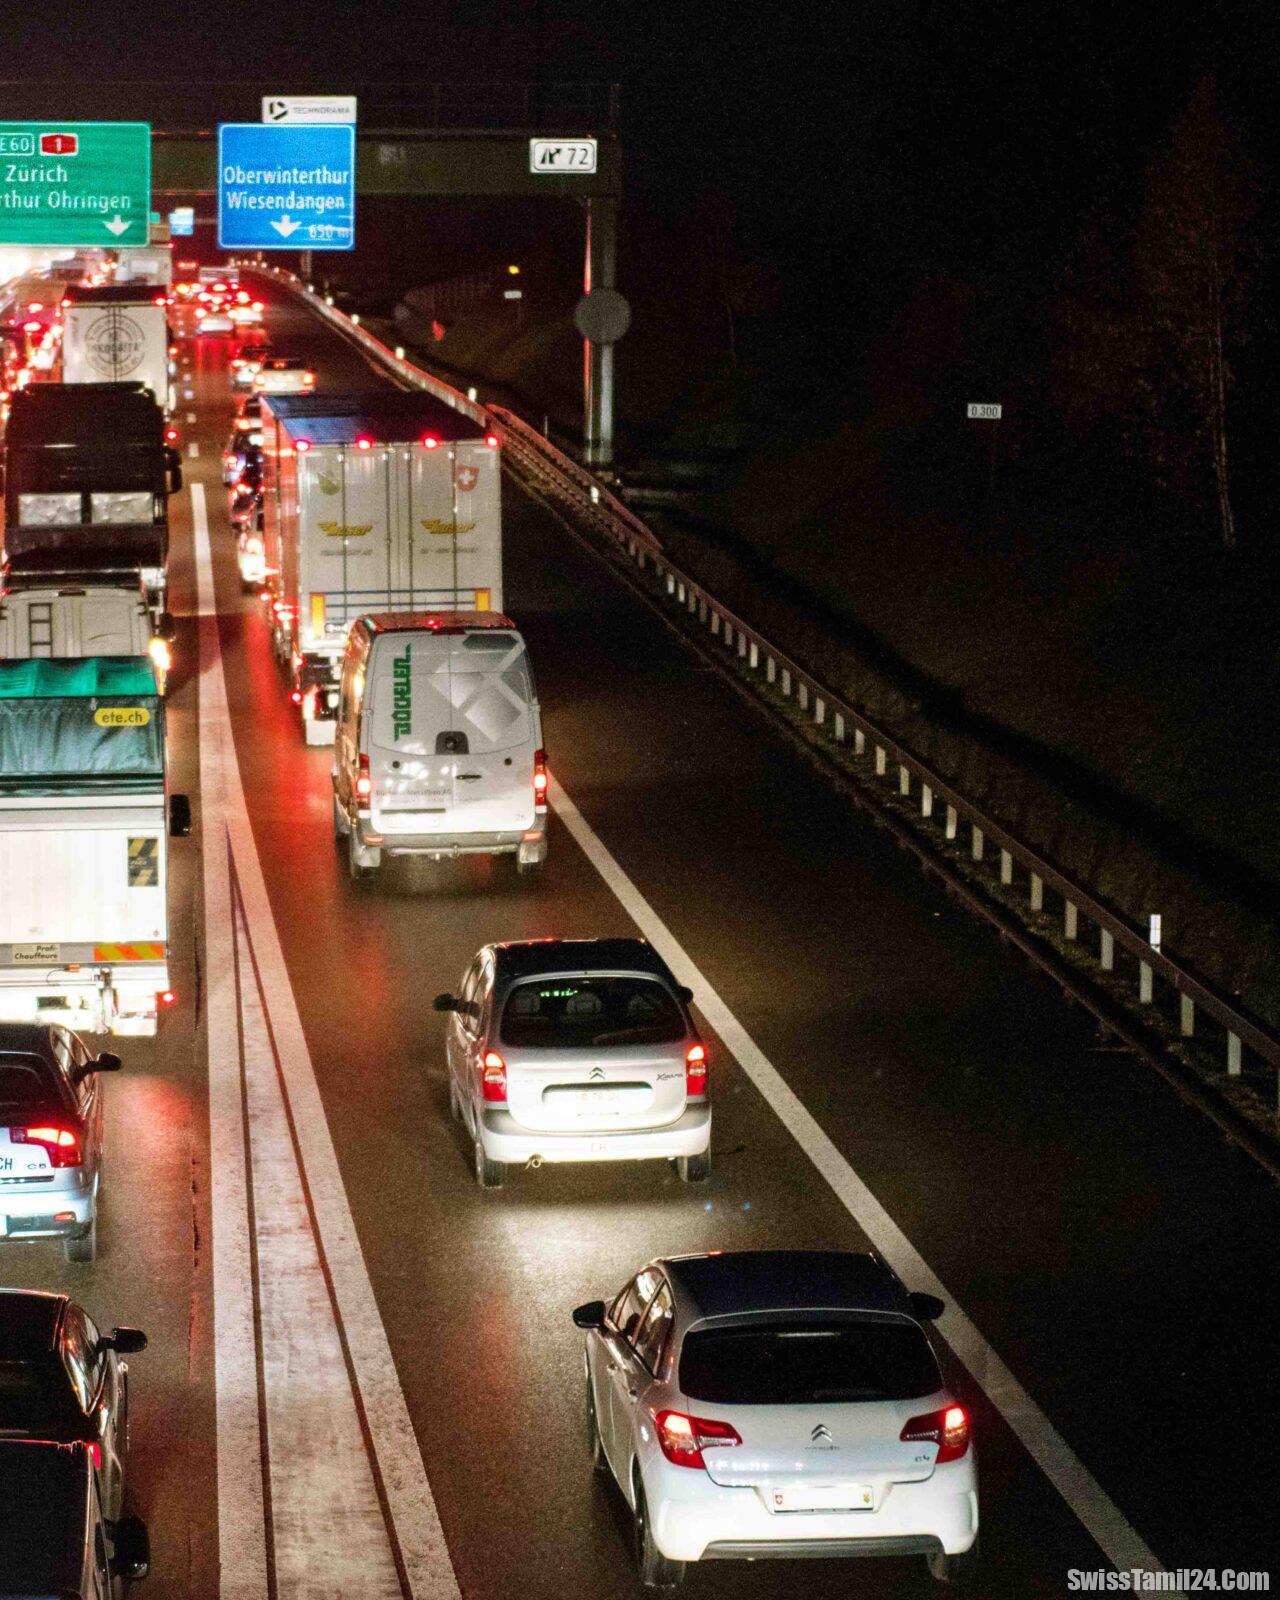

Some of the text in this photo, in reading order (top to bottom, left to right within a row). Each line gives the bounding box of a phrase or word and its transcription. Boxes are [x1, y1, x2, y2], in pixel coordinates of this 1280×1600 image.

[55, 137, 62, 151] 1
[567, 147, 589, 165] 72
[5, 164, 68, 182] Zürich
[223, 165, 349, 184] Oberwinterthur
[48, 190, 131, 213] Ohringen
[226, 190, 345, 214] Wiesendangen
[102, 711, 143, 723] ete.ch
